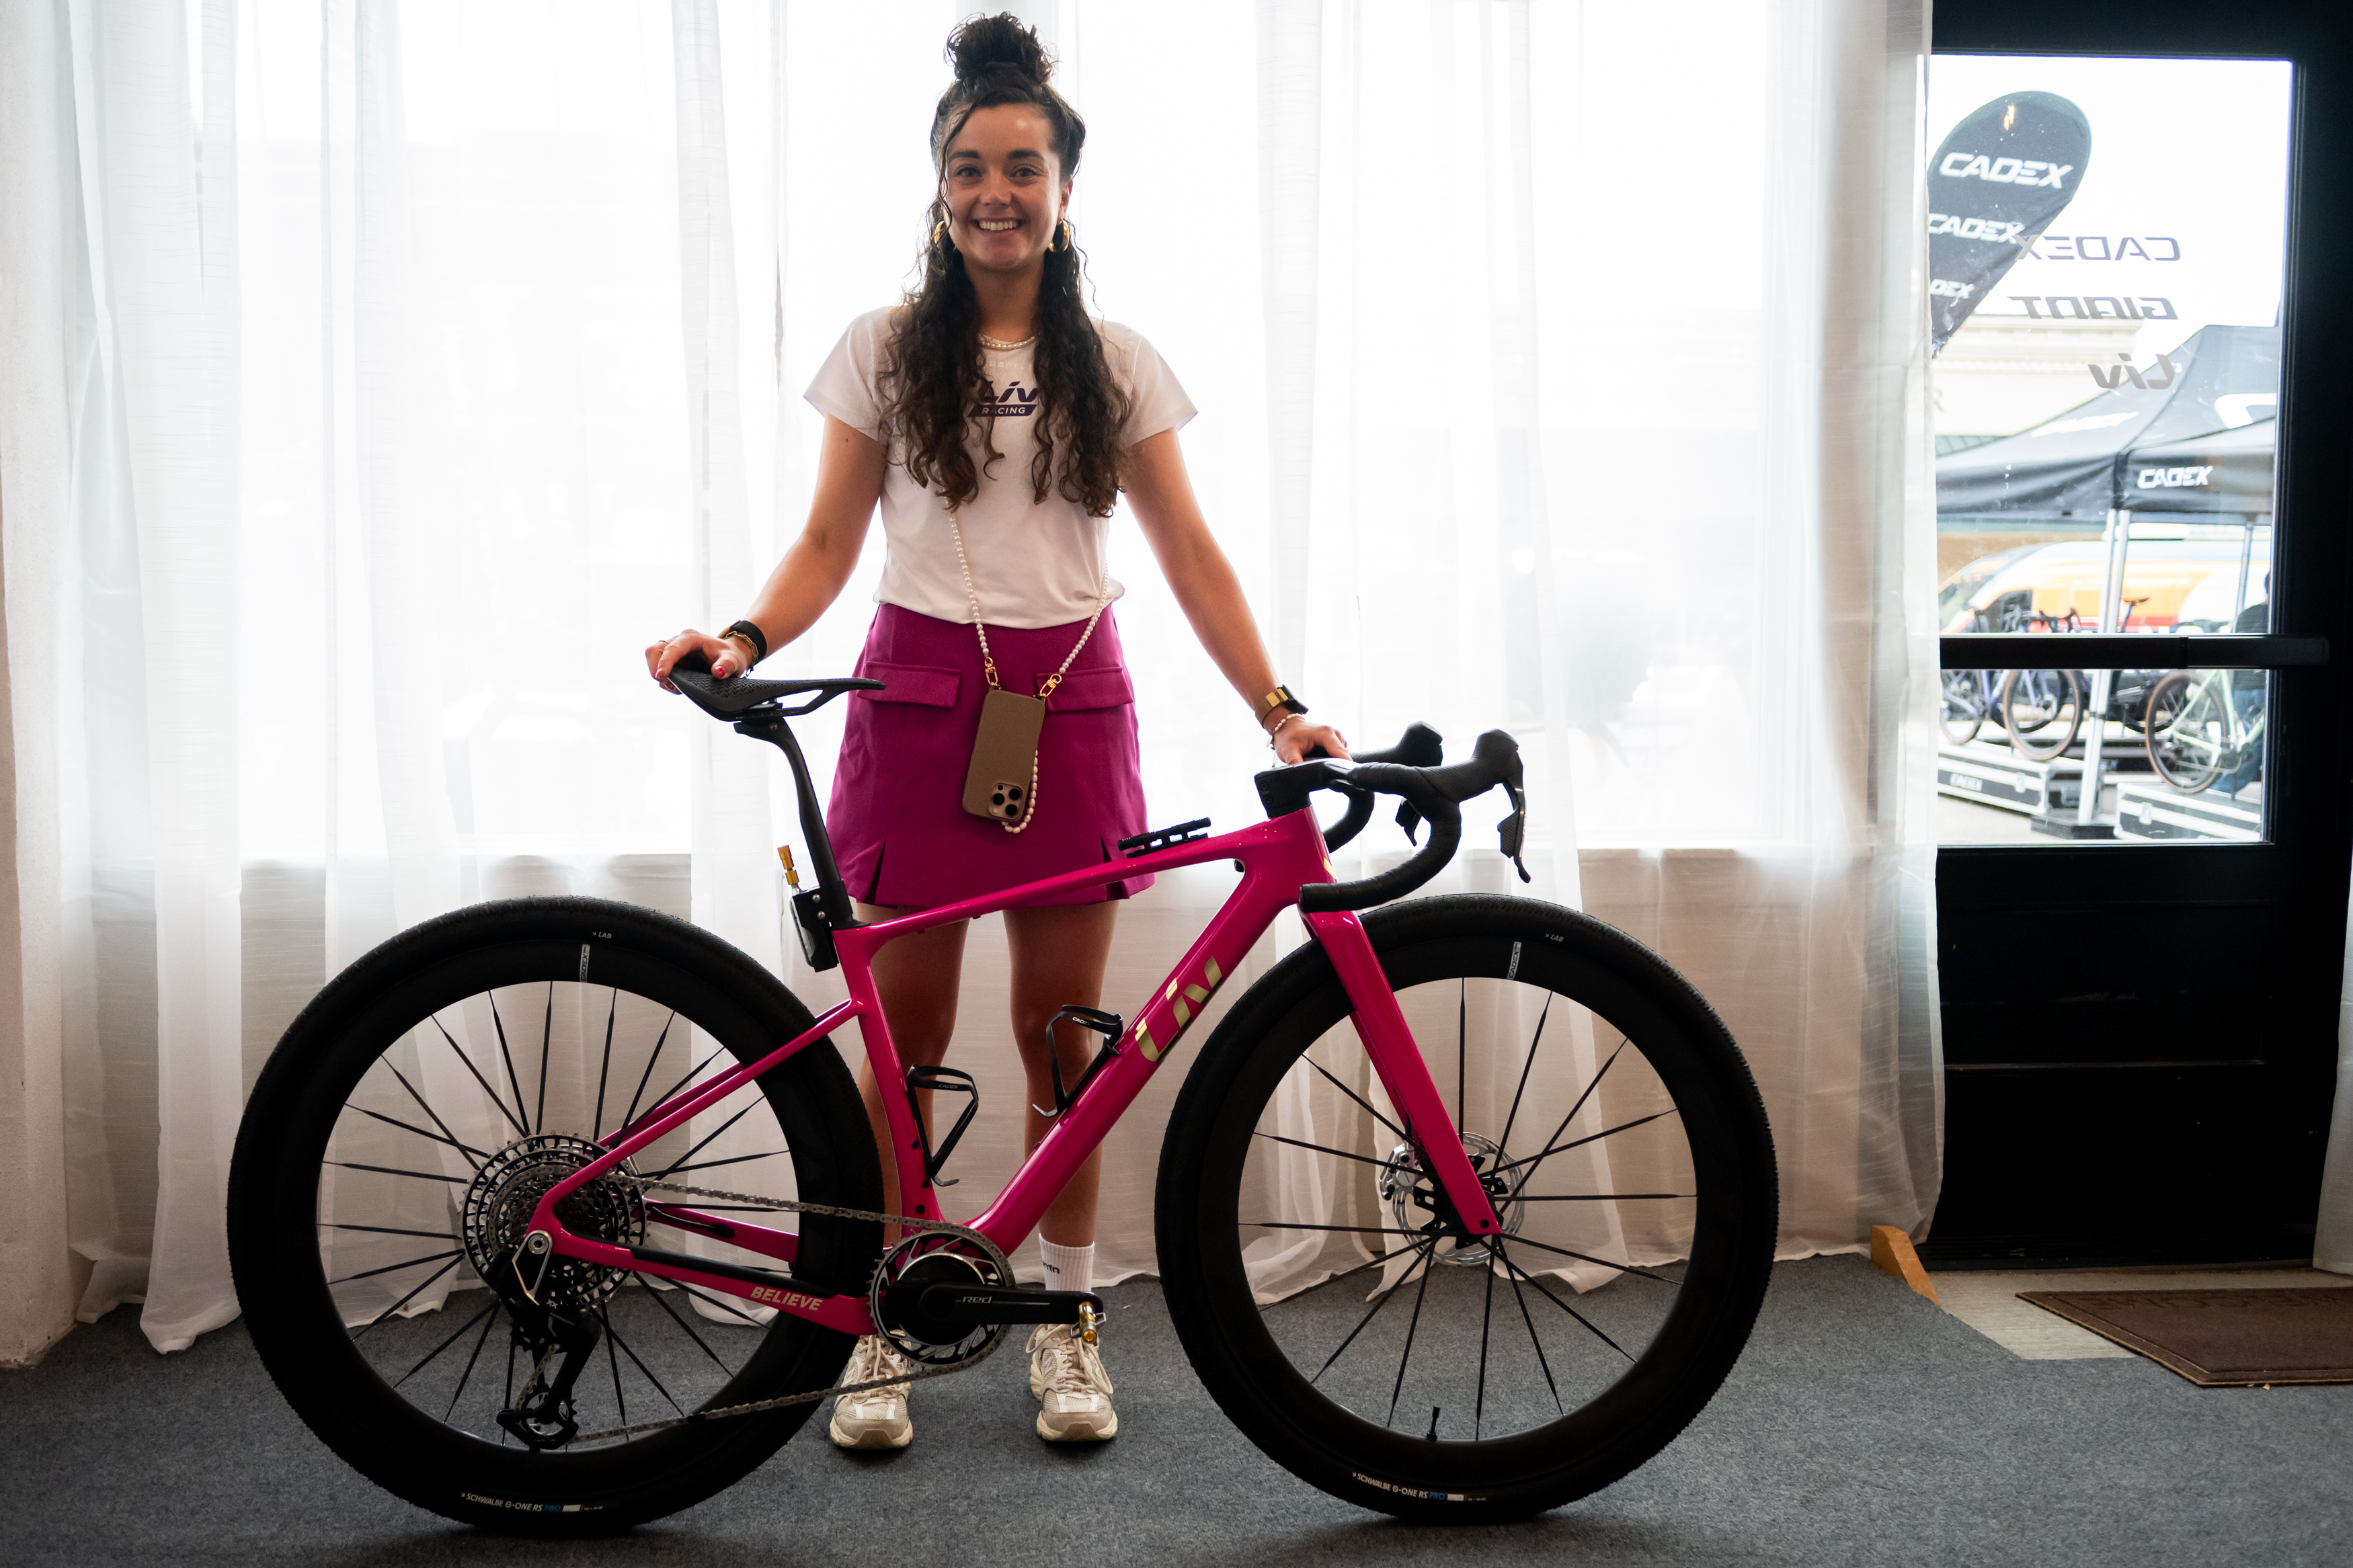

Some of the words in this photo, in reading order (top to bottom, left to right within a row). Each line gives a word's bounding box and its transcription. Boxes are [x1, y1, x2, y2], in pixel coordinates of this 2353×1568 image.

[1940, 152, 2073, 189] CADEX
[1929, 213, 2025, 244] CADEX
[1930, 279, 1975, 299] DEX
[2137, 466, 2214, 489] CADEX
[1550, 934, 1564, 942] LAB
[1509, 950, 1519, 978] CADEX
[750, 1286, 823, 1311] BELIEVE
[1357, 1473, 1391, 1491] SCHWALBE
[1392, 1485, 1418, 1497] G-ONE
[1419, 1491, 1428, 1499] RS
[1429, 1492, 1445, 1500] PRO
[466, 1493, 504, 1507] SCHWALBE
[505, 1501, 532, 1512] G-ONE
[532, 1504, 543, 1512] RS
[544, 1504, 561, 1512] PRO
